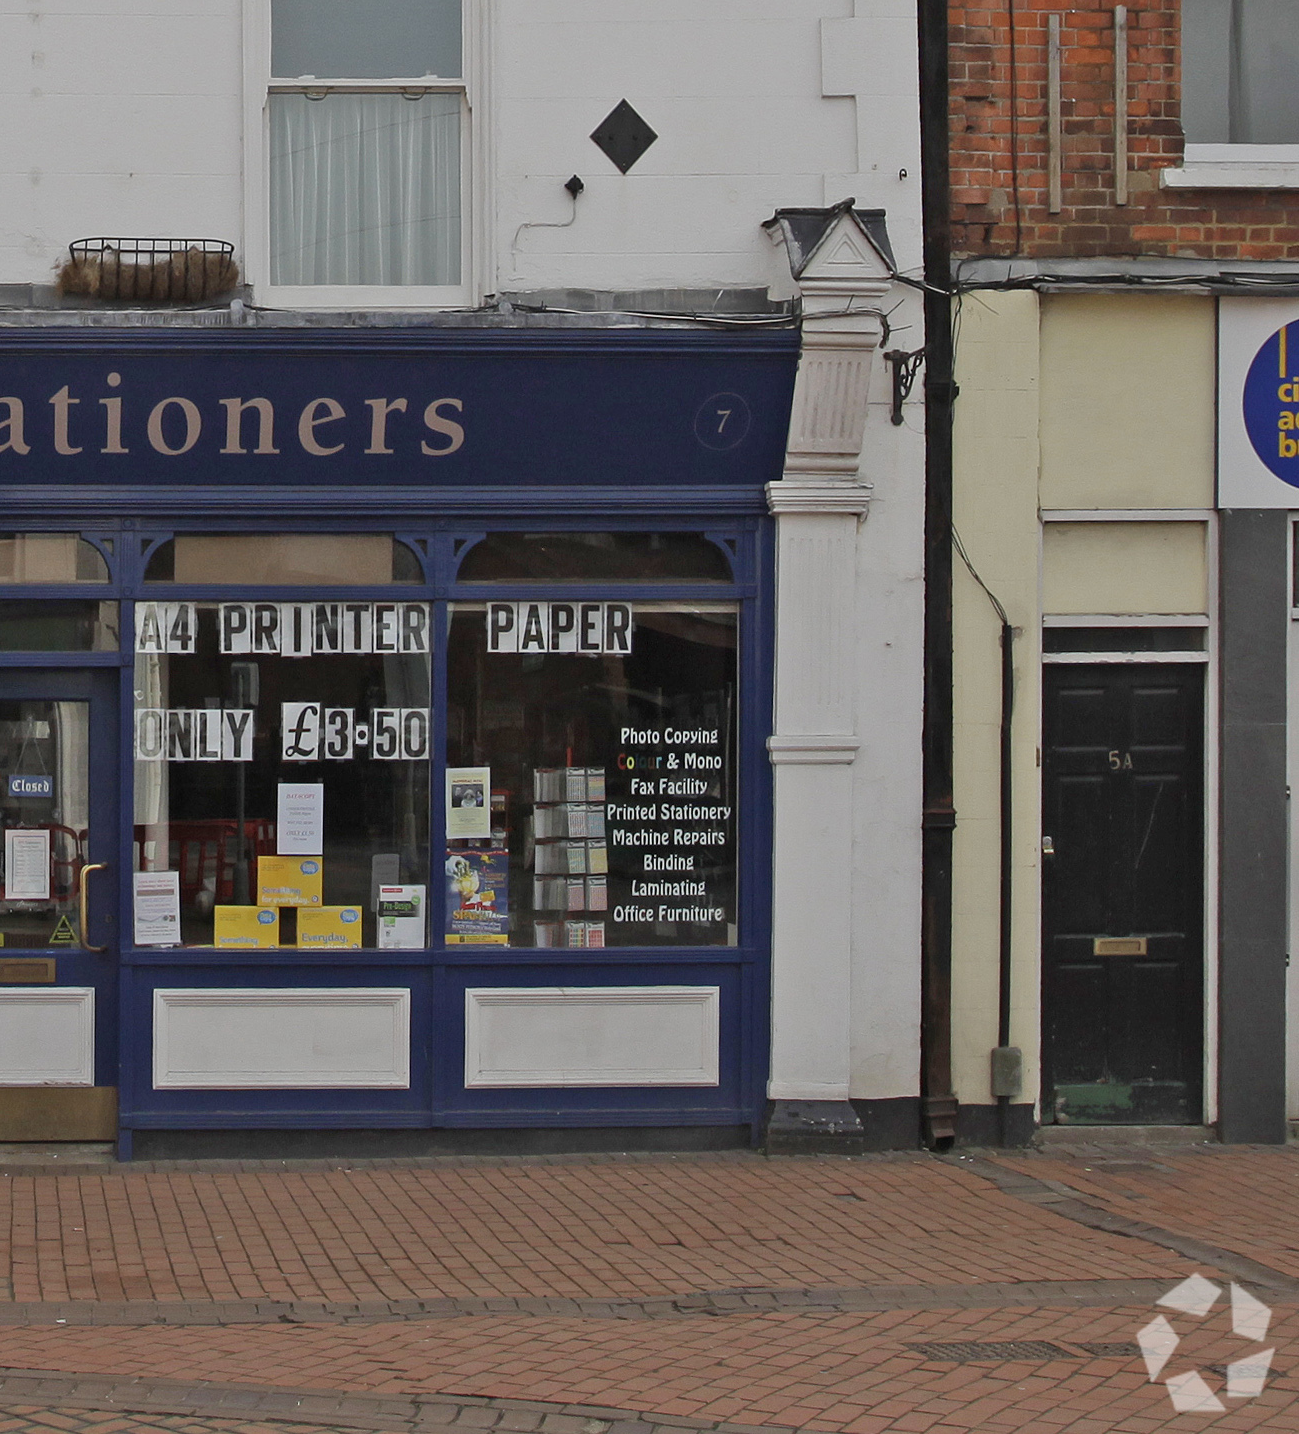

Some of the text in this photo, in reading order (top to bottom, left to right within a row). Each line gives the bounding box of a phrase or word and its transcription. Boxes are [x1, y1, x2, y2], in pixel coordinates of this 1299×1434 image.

[716, 409, 732, 433] 7
[139, 603, 631, 653] A4 PRINTER PAPER
[139, 710, 252, 759] ONLY
[621, 727, 718, 744] Photo Copying
[617, 753, 722, 769] Colour & Mono
[1109, 750, 1133, 770] 5A
[12, 779, 49, 792] Closed
[631, 778, 708, 795] Fax Facility
[607, 804, 731, 820] Printed Stationery
[612, 829, 725, 845] Machine Repairs
[643, 854, 694, 871] Binding
[631, 879, 706, 896] Laminating
[613, 905, 723, 922] Office Furniture
